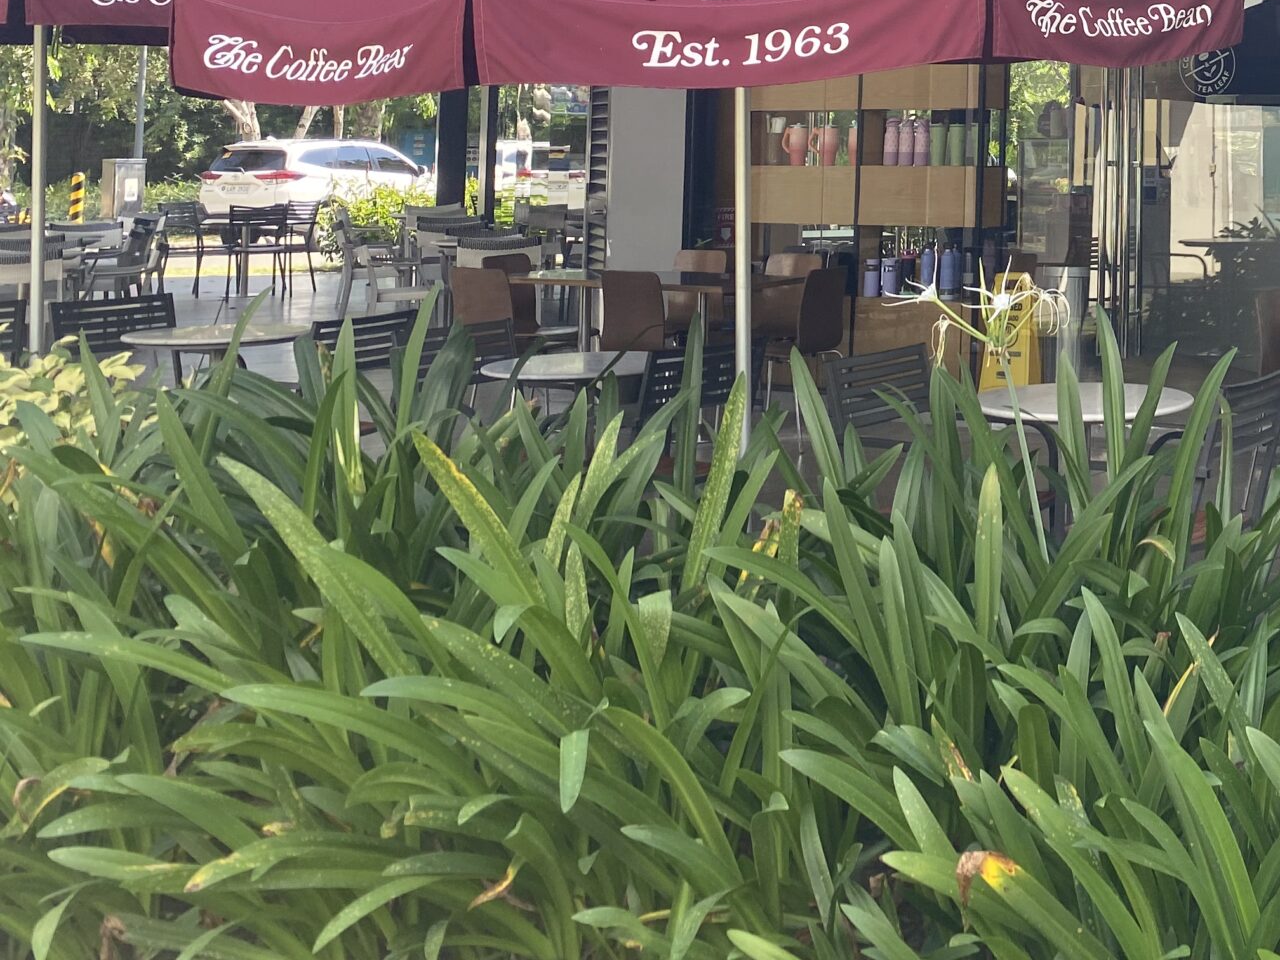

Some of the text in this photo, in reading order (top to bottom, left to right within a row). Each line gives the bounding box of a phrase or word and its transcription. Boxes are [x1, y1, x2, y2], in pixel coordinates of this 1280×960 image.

[1078, 6, 1152, 37] Coffee
[1148, 3, 1212, 32] Bean
[203, 34, 263, 74] The
[265, 45, 353, 82] Coffee
[632, 22, 850, 67] Est. 1963
[1197, 70, 1230, 93] TEA LEAF
